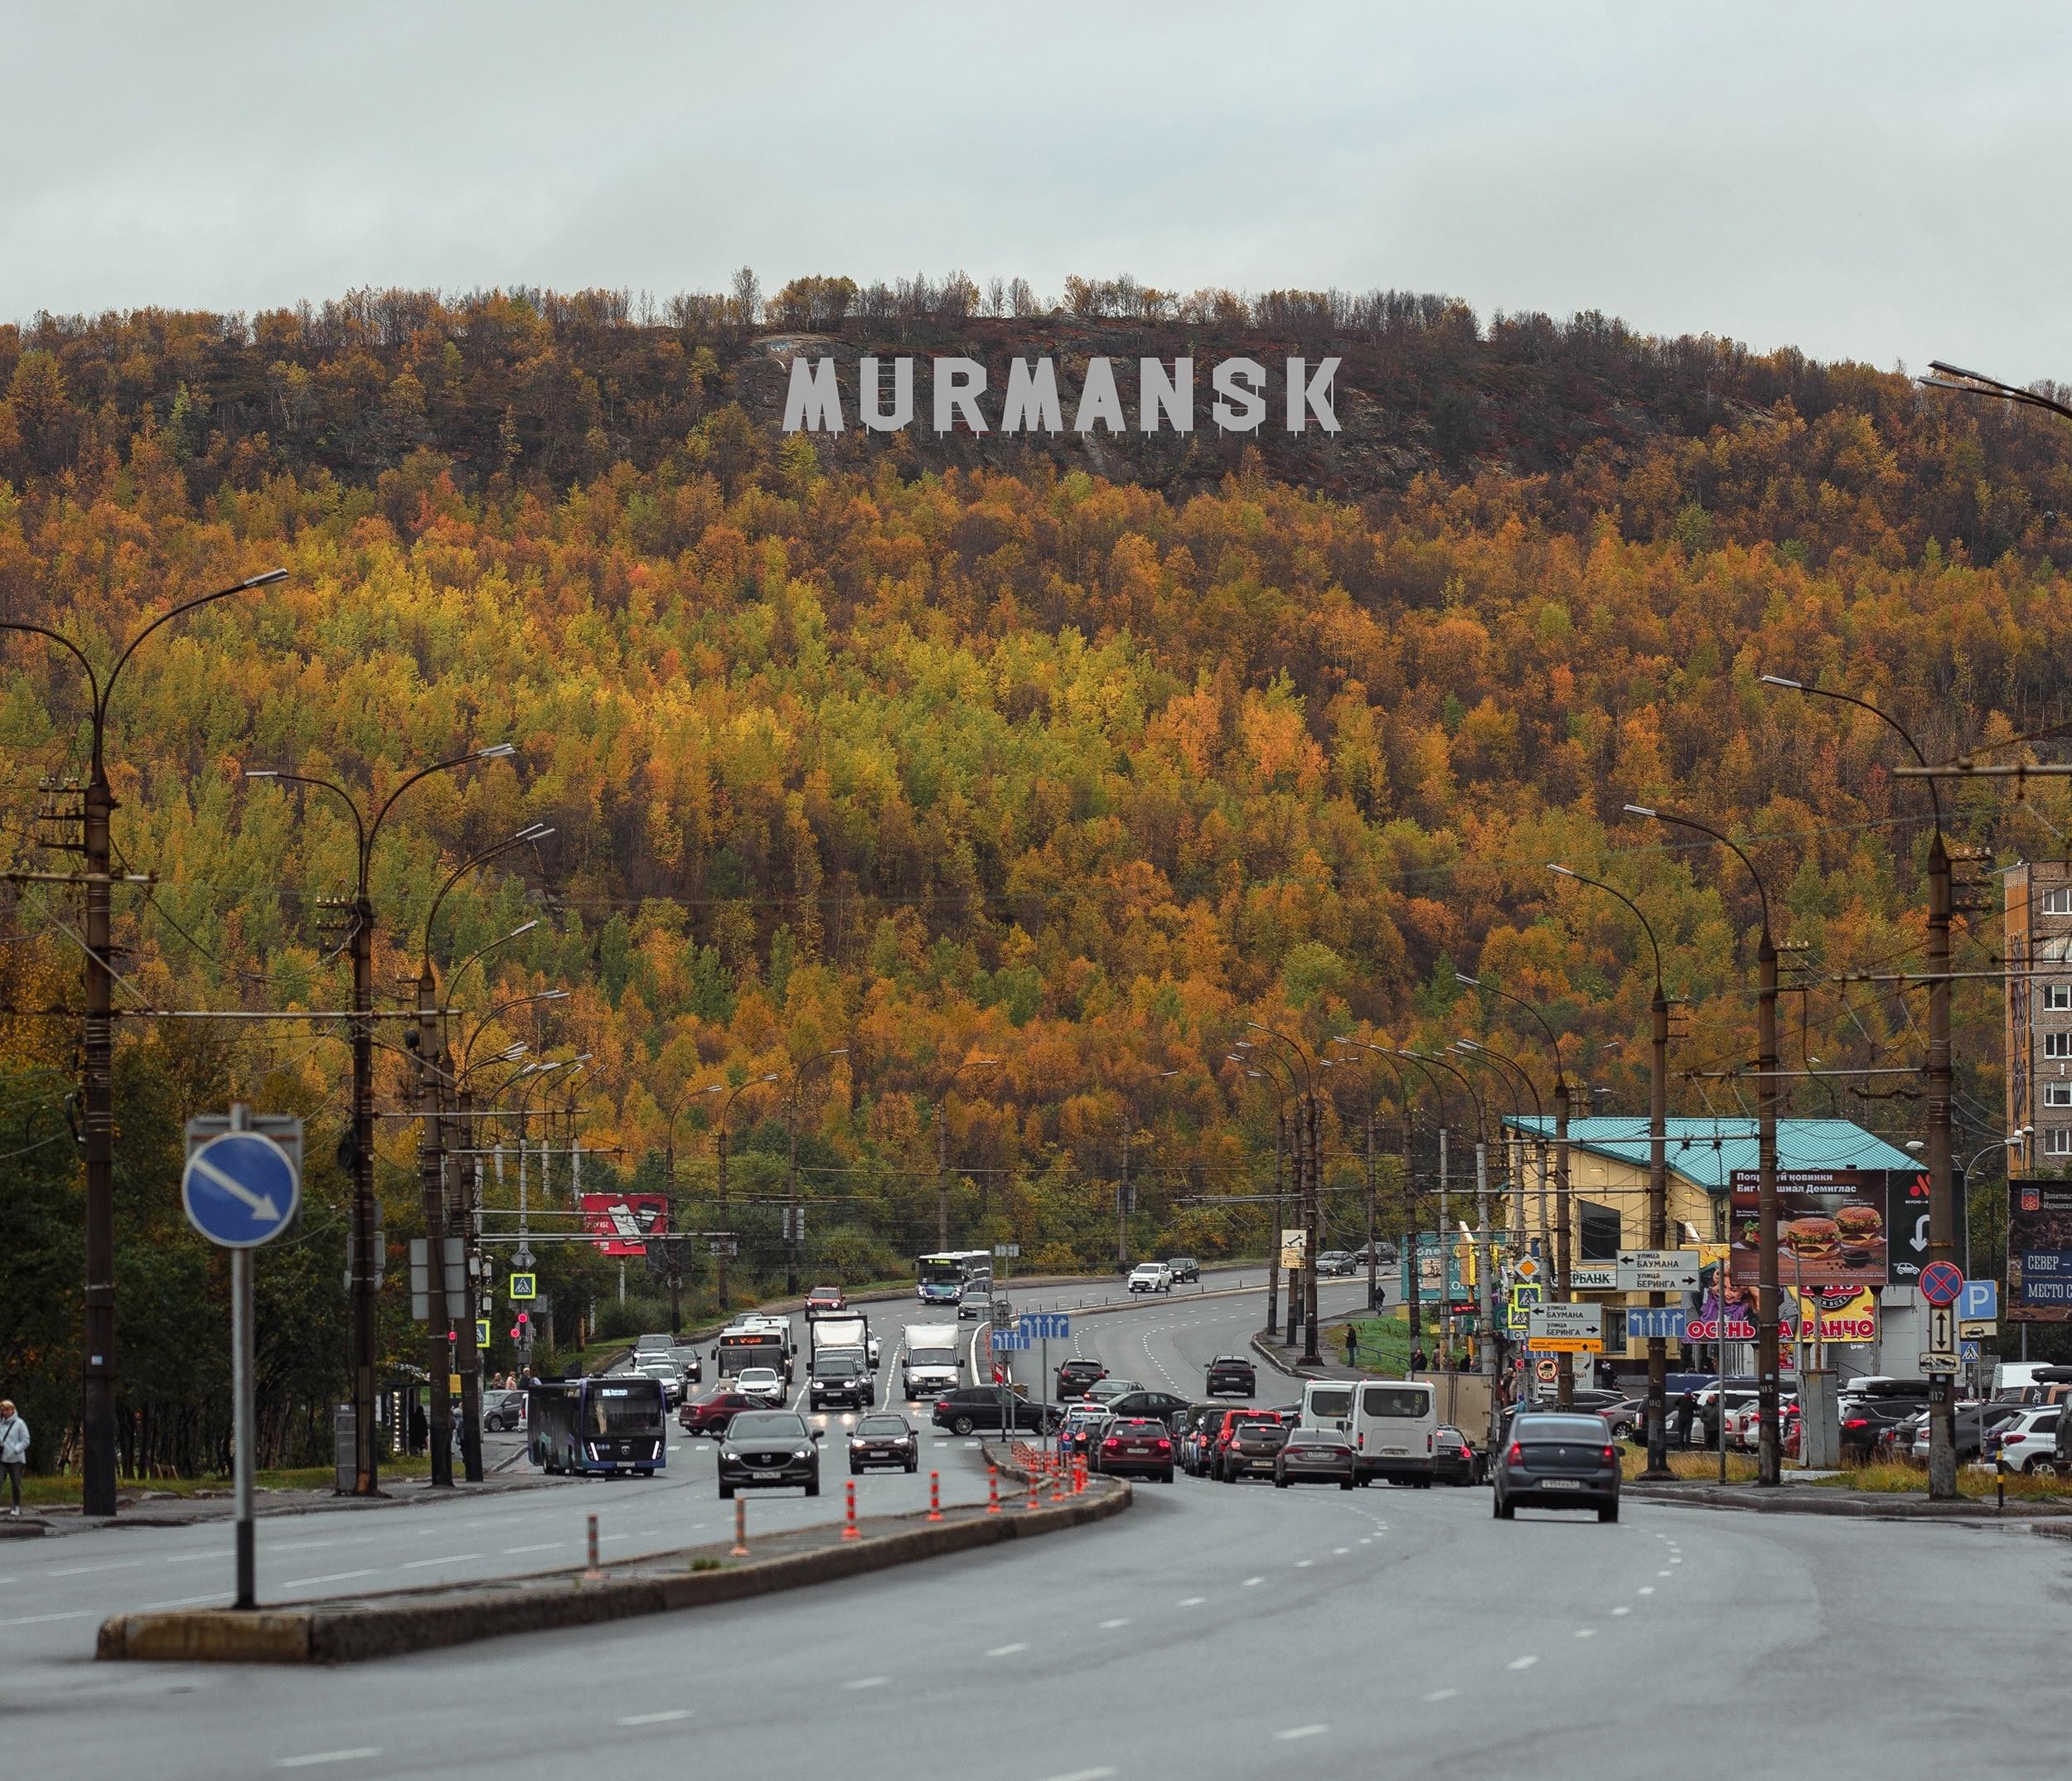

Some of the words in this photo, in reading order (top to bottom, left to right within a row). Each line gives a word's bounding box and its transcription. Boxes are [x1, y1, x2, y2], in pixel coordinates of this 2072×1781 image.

[782, 357, 1343, 432] MURMANSK
[1737, 1184, 1756, 1193] Биг
[1806, 1184, 1857, 1194] Демиглас
[1637, 1260, 1679, 1268] БАУМАНА
[2027, 1255, 2060, 1270] СЕВЕР
[2027, 1284, 2063, 1299] МЕСТО
[1969, 1285, 1989, 1315] P
